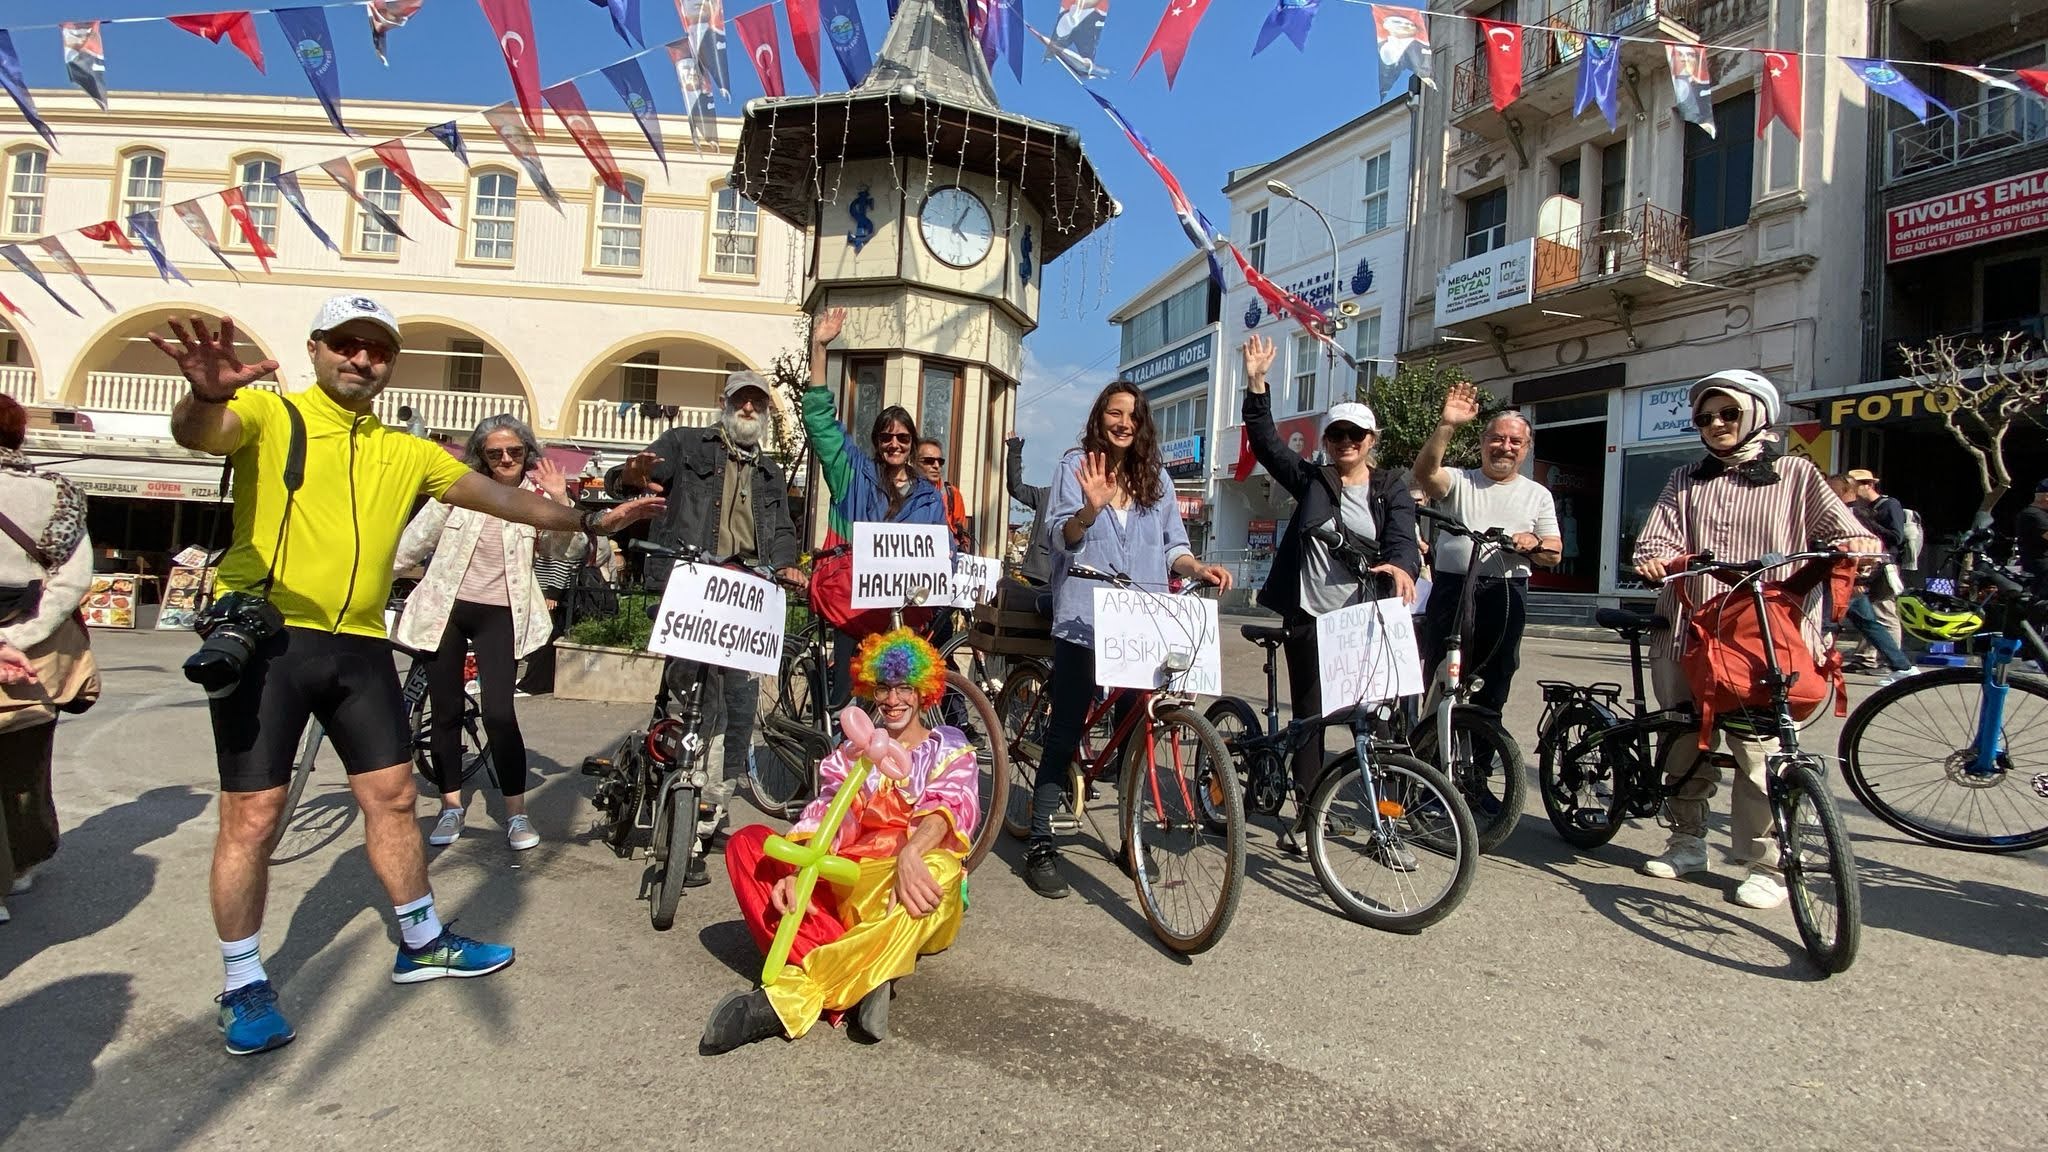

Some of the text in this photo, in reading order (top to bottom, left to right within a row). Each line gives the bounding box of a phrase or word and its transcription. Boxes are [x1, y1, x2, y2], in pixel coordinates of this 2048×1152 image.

[1894, 190, 1987, 228] TIVOLI'S
[1981, 211, 1990, 221] &
[1447, 266, 1491, 287] MEGLAND
[1447, 275, 1491, 298] PEYZAJ
[1178, 342, 1207, 367] HOTEL
[1831, 386, 1960, 425] FOTO
[1173, 447, 1193, 460] HOTEL
[147, 482, 181, 491] GÜVEN
[873, 533, 935, 558] KIYILAR
[704, 575, 765, 613] ADALAR
[858, 572, 948, 598] HALKINDIR
[1102, 591, 1201, 622] ARABADAN
[660, 609, 780, 660] ŞEHİRLEŞMESİN
[1323, 615, 1335, 634] TO
[1336, 631, 1357, 651] THE
